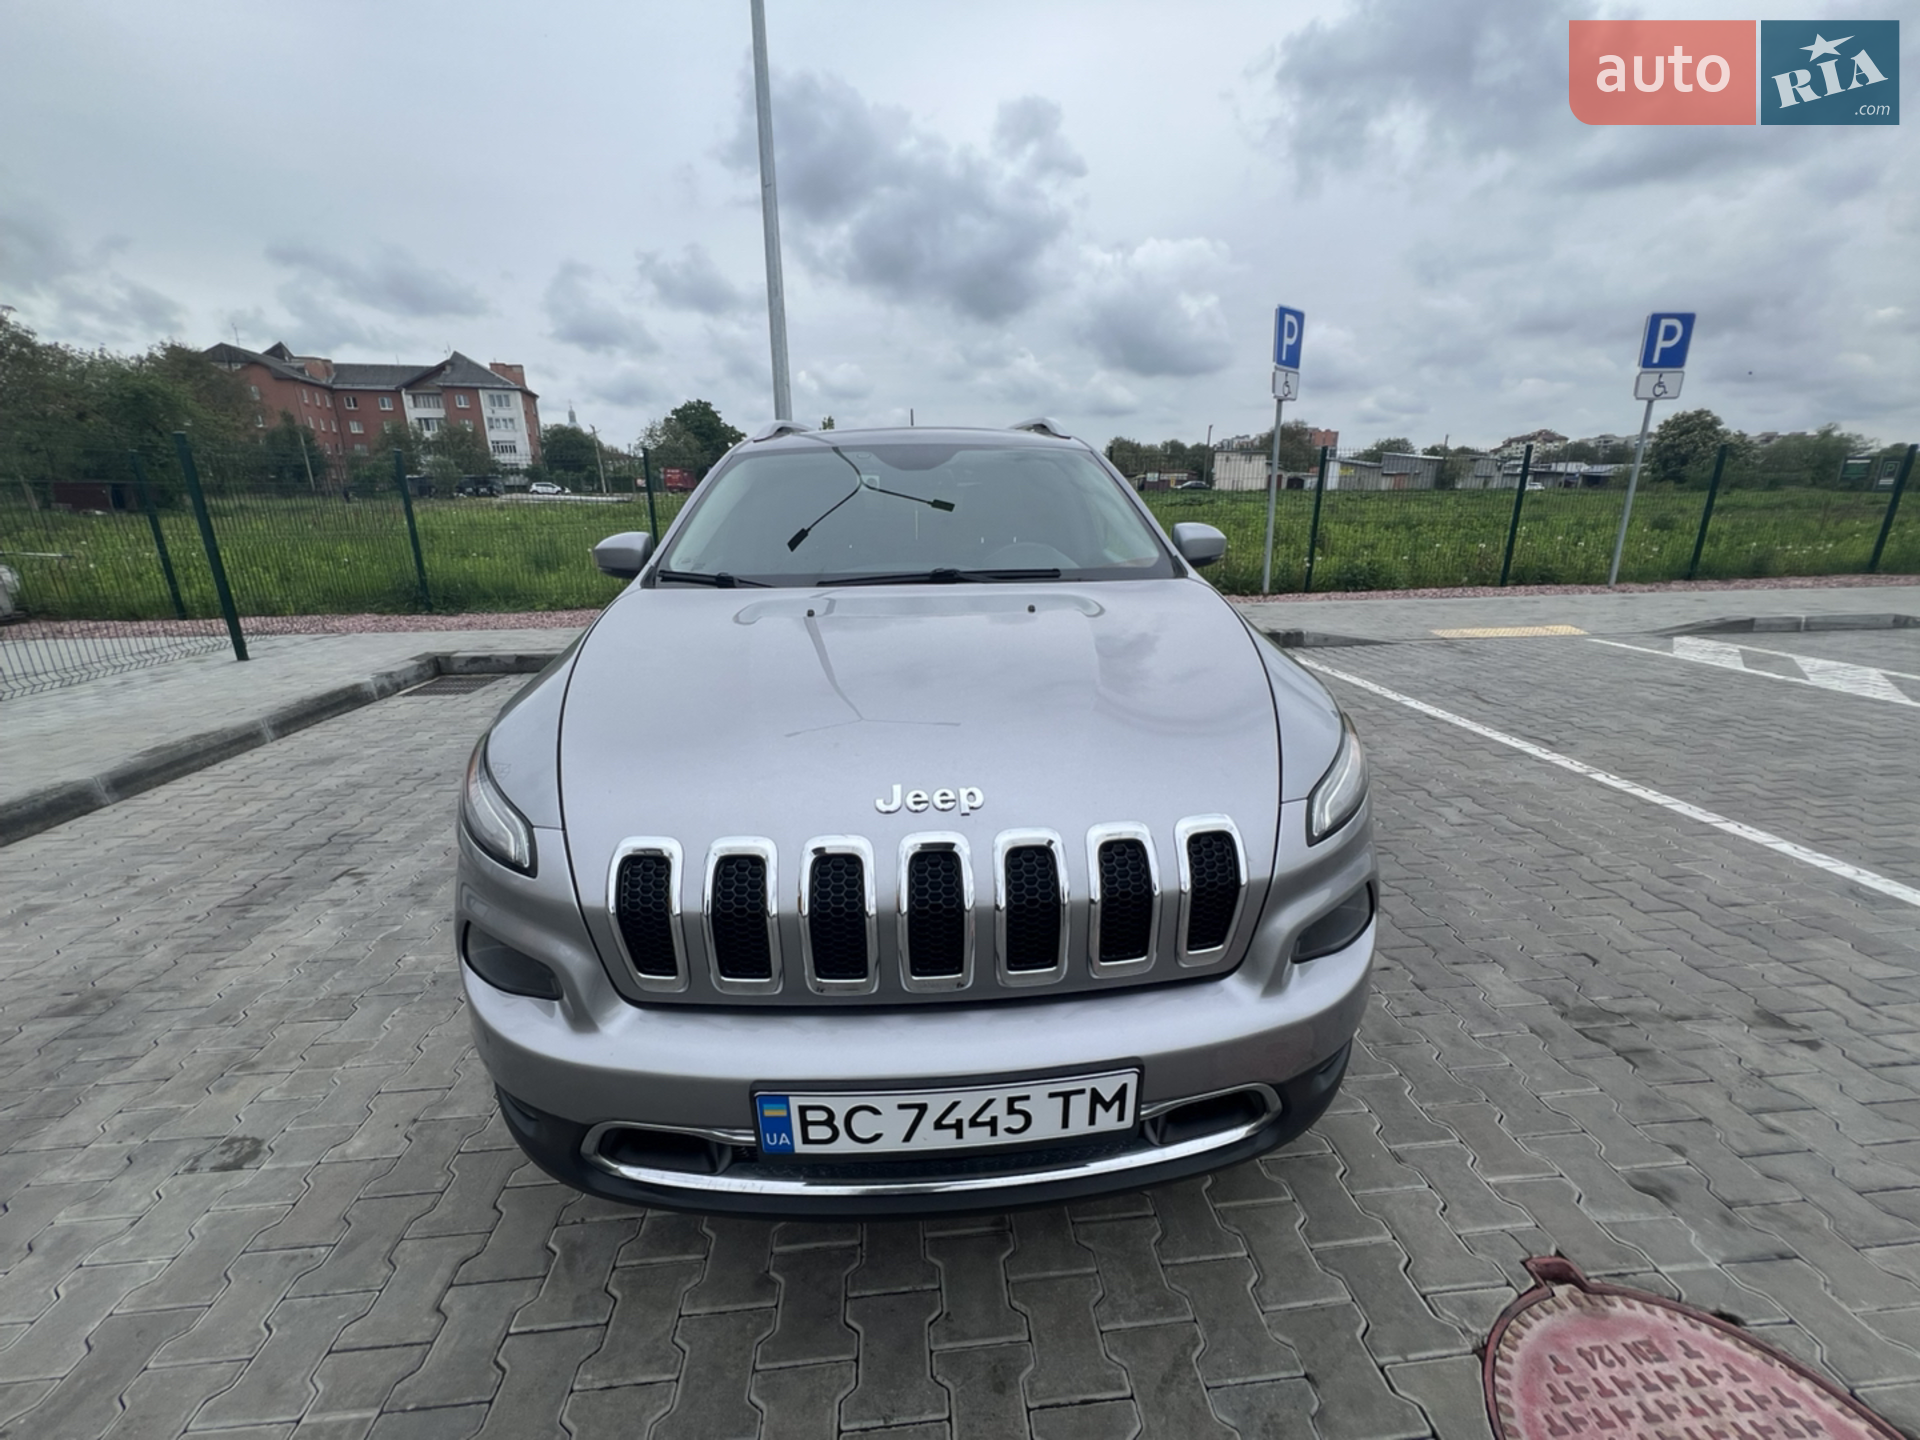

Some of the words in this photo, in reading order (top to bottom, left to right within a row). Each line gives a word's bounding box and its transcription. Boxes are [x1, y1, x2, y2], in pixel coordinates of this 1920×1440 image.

[1282, 313, 1298, 361] P
[1652, 318, 1683, 364] P
[875, 784, 984, 816] Jeep
[798, 1104, 884, 1146] BC
[897, 1094, 1033, 1144] 7445
[1048, 1082, 1129, 1130] TM
[766, 1133, 791, 1146] UA
